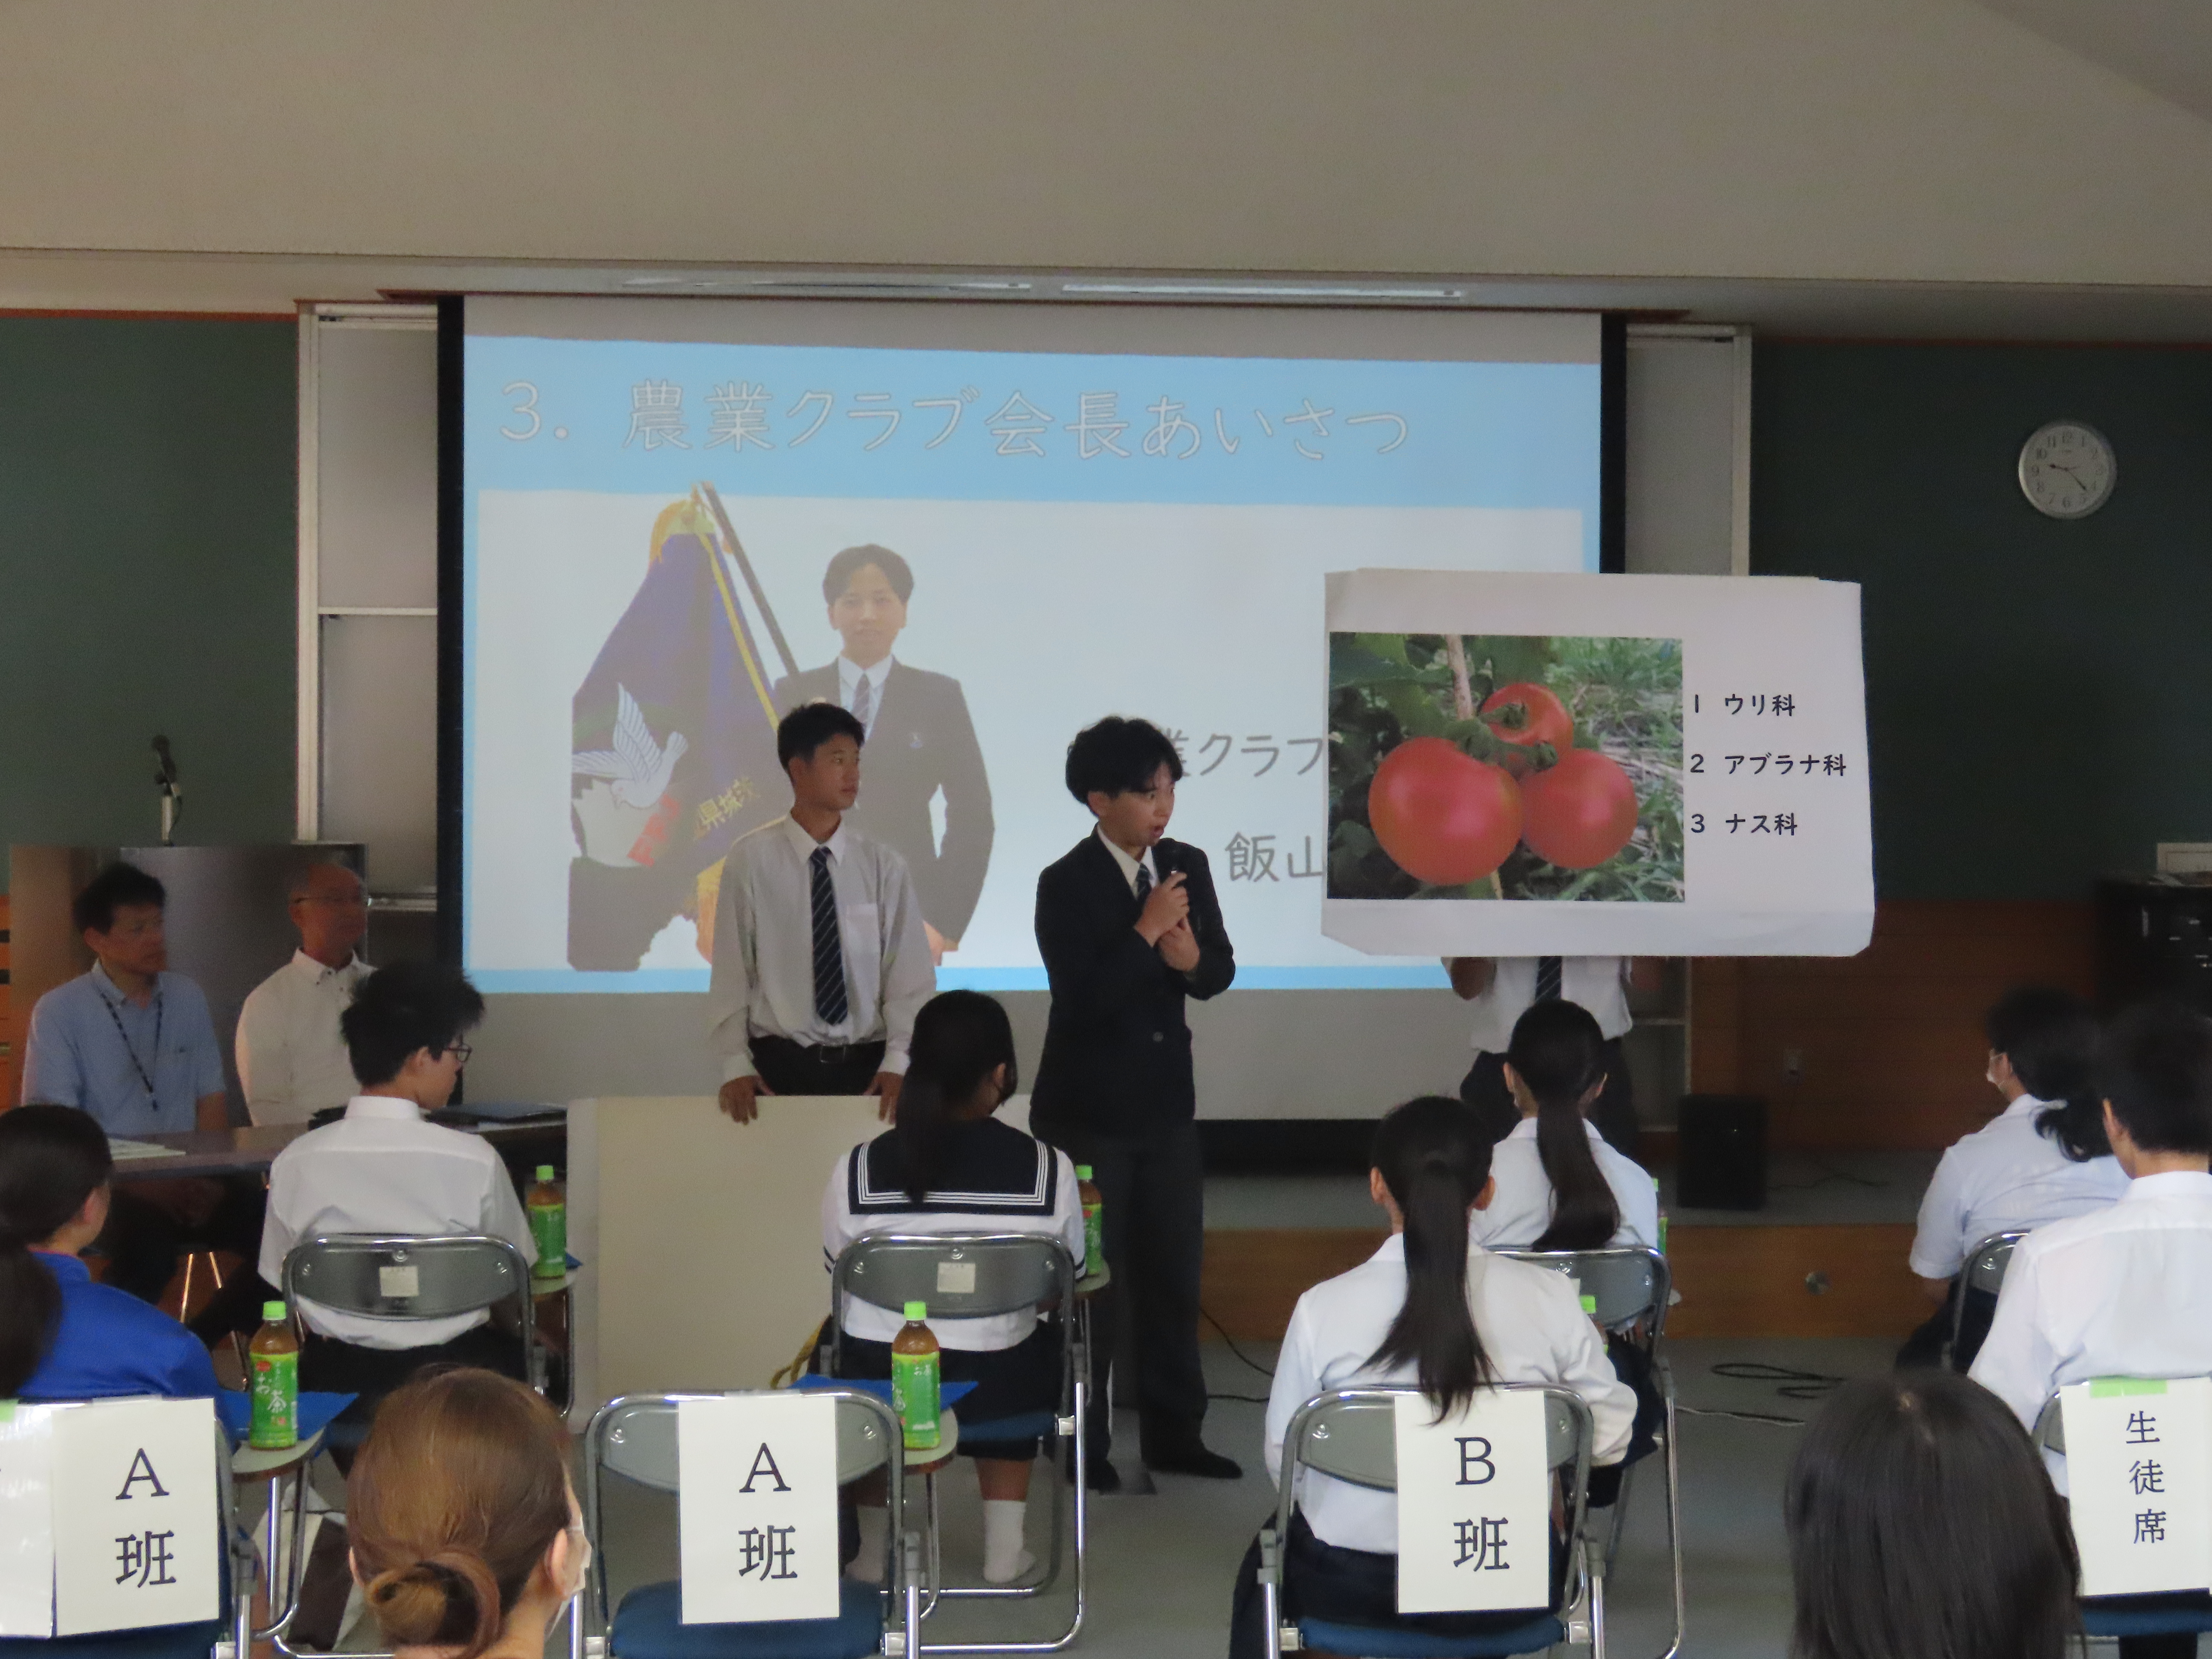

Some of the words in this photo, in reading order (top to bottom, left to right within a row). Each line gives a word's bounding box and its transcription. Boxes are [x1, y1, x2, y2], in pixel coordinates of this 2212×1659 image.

[622, 378, 1408, 460] 農業クラブ会長あいさつ
[1725, 693, 1796, 716] ウリ科
[1690, 754, 1705, 773] 2
[1725, 752, 1846, 777] アブラナ科
[1691, 813, 1705, 833] 3
[1726, 812, 1798, 836] ナス科
[2125, 1410, 2166, 1544] 生徒席
